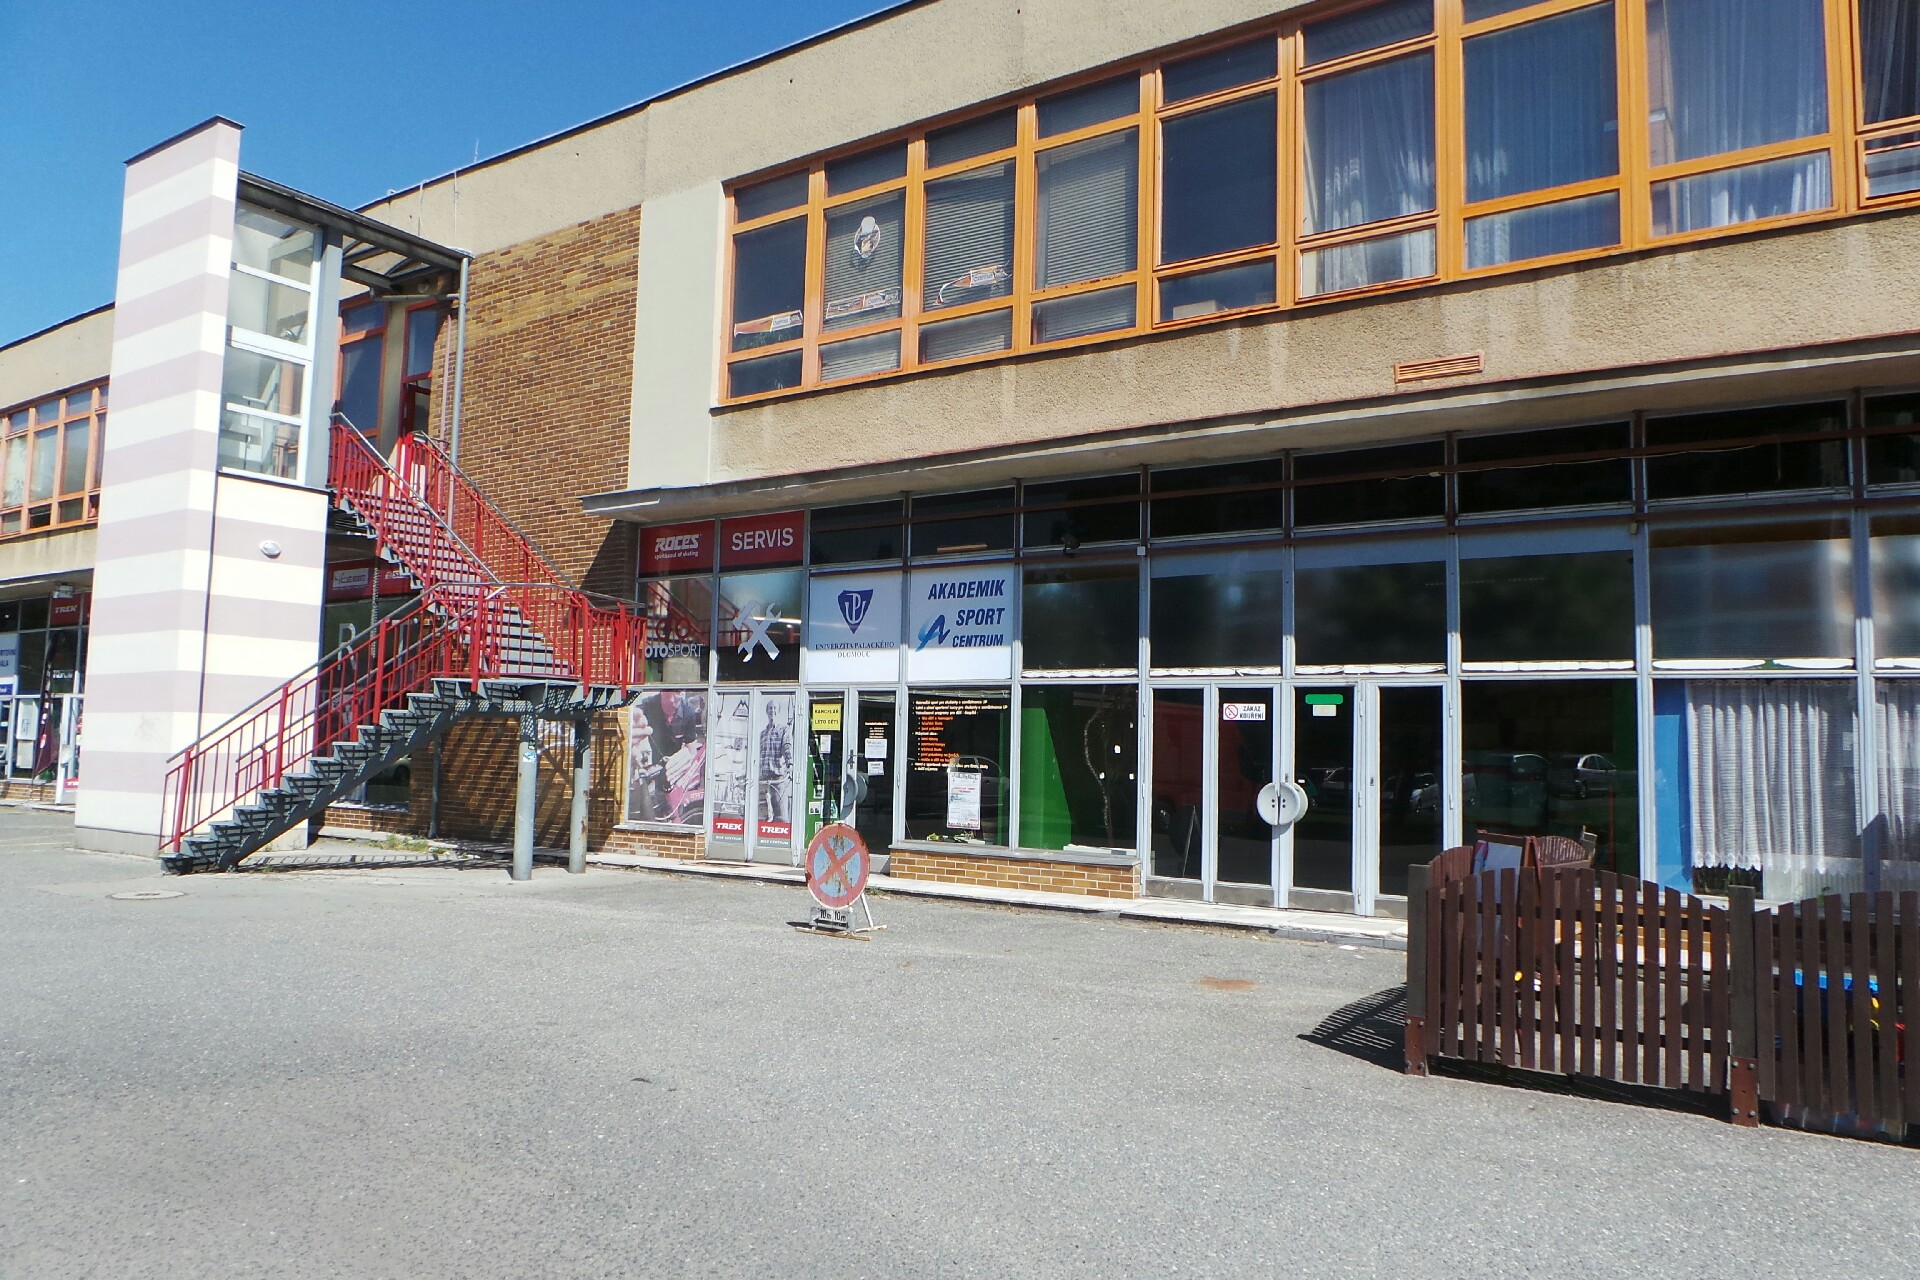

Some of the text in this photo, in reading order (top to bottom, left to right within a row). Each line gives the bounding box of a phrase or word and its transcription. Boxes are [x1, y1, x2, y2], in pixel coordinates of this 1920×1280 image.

[655, 534, 700, 552] ROCES
[732, 527, 794, 551] SERVIS
[927, 579, 1006, 600] AKADEMIK
[55, 604, 78, 614] TREK
[955, 607, 1006, 627] SPORT
[815, 640, 895, 650] UNIVERZITA PALACKÉHO
[952, 633, 1004, 648] CENTRUM
[837, 650, 871, 658] OLOMOUC
[716, 822, 742, 830] TREK
[760, 825, 789, 834] TREK
